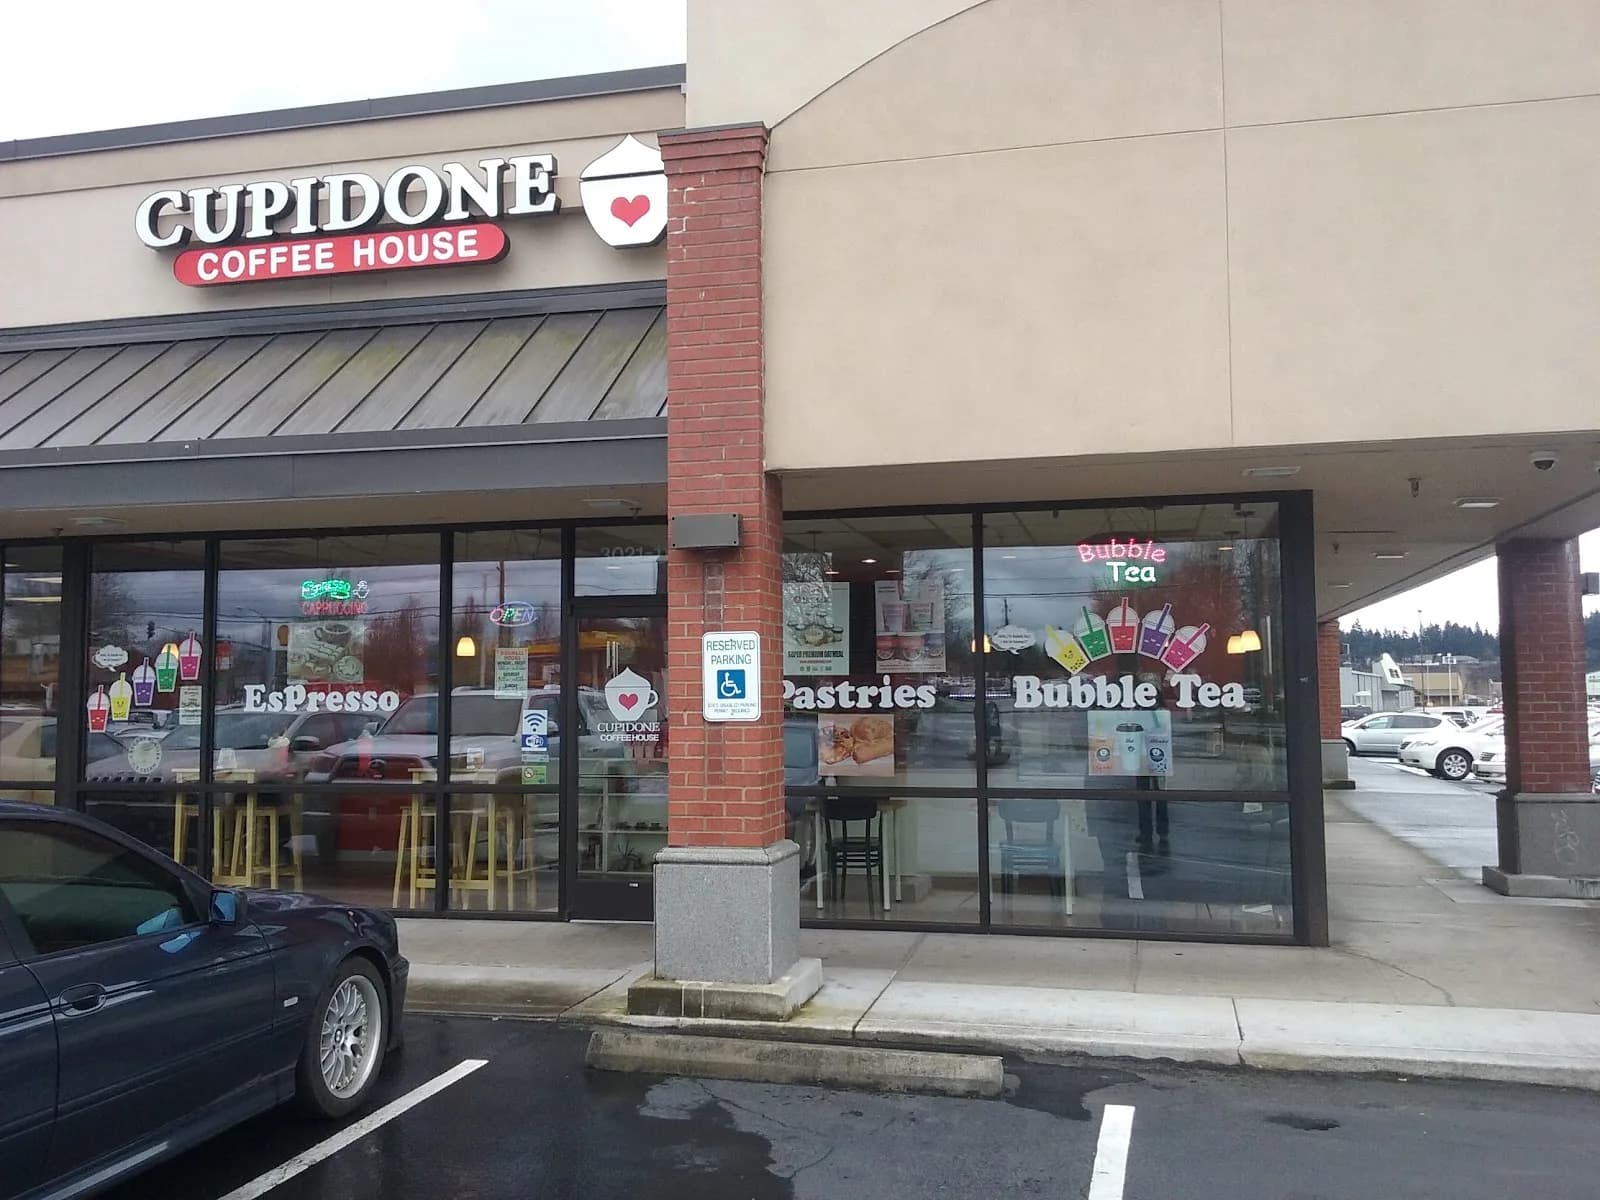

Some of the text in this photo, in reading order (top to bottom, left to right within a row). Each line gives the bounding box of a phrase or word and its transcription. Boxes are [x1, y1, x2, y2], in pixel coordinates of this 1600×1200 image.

[135, 153, 557, 249] CUPIDONE
[197, 229, 479, 281] COFFEE HOUSE
[1078, 538, 1166, 562] Bubble
[1105, 561, 1157, 582] Tea
[490, 607, 533, 623] OPEN
[706, 640, 756, 651] RESERVED
[711, 654, 752, 665] PARKING
[1013, 674, 1246, 709] Bubble Tea
[597, 722, 661, 732] CUPIDONE
